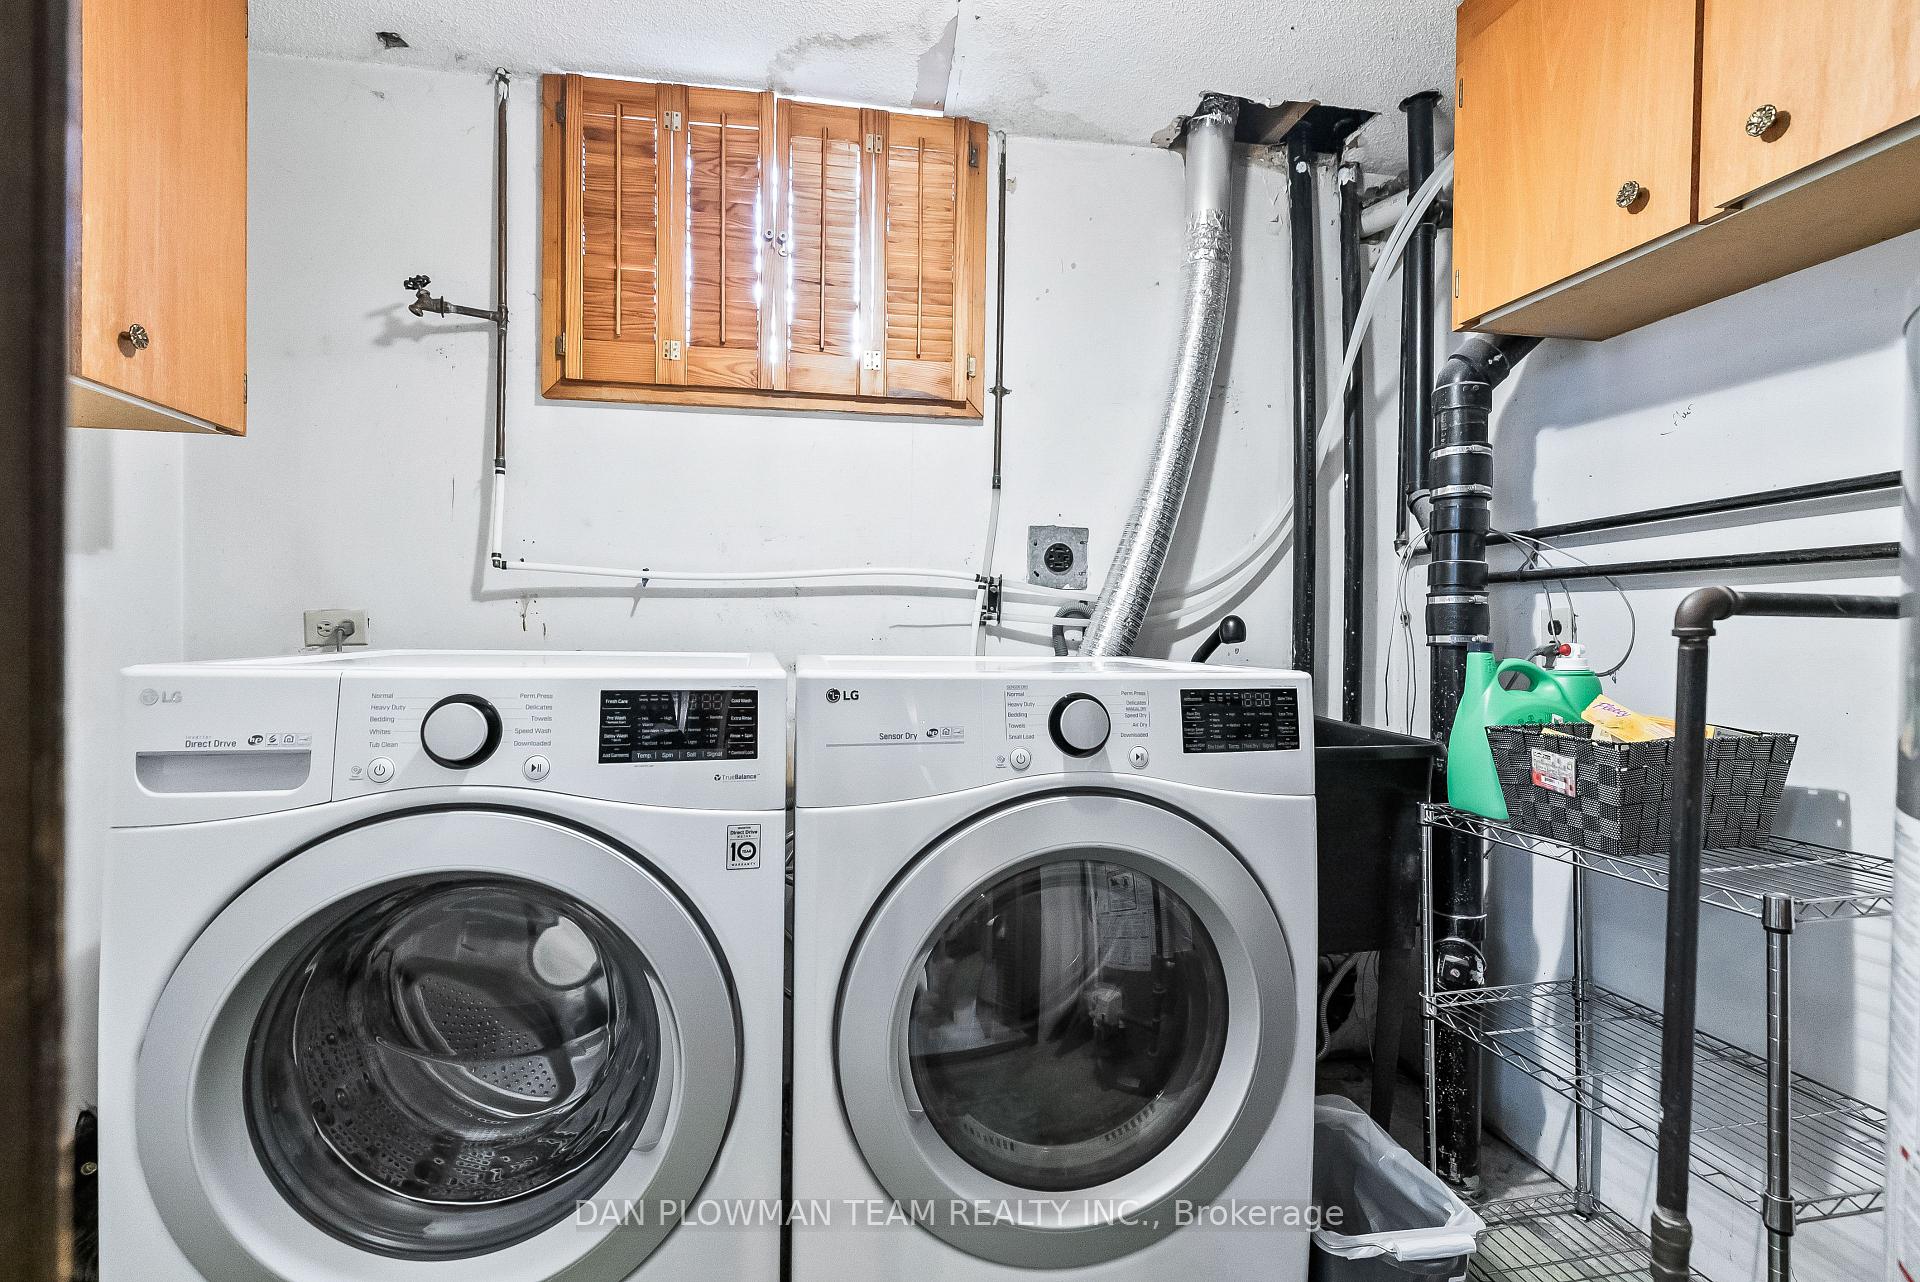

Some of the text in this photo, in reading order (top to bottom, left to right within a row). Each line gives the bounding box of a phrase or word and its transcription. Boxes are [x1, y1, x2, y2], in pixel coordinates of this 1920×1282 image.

[161, 691, 182, 703] LG
[843, 690, 860, 701] LG
[880, 732, 918, 741] Sensor Dry
[185, 740, 237, 748] Direct Drive
[731, 842, 756, 861] 10
